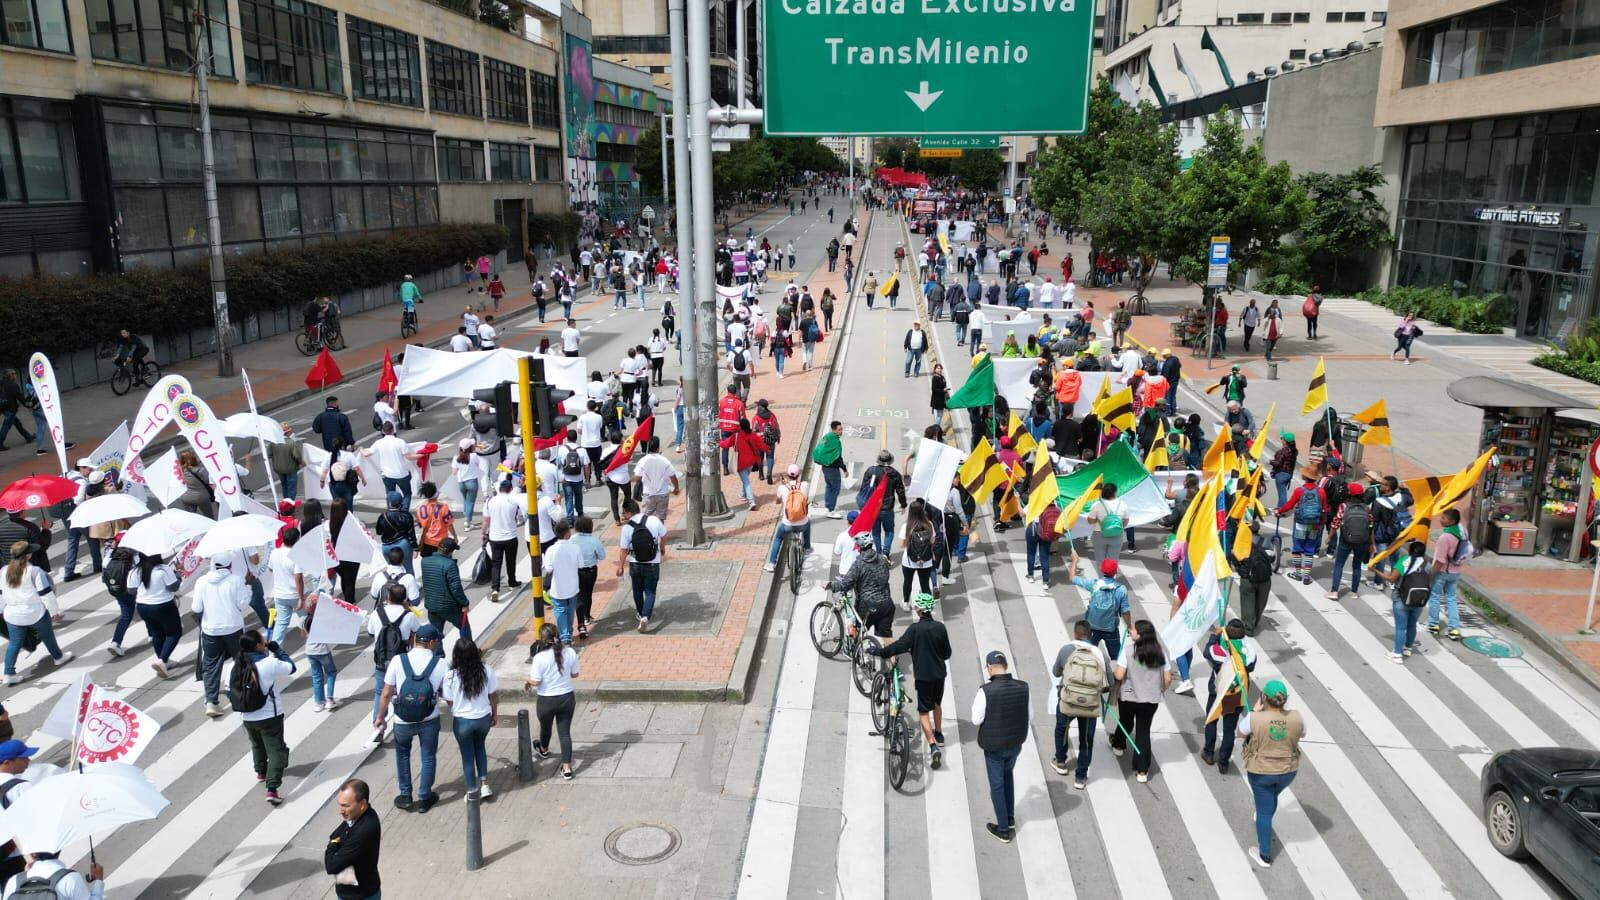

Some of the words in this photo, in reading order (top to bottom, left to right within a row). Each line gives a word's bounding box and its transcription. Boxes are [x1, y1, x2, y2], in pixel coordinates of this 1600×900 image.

[782, 0, 905, 15] Calzada
[921, 0, 1077, 14] Exclusiva
[825, 37, 1029, 65] TransMilenio
[1480, 208, 1518, 223] ANYTIME
[1518, 210, 1561, 225] FITNESS
[129, 402, 170, 454] CTC
[194, 429, 237, 496] CTC
[87, 717, 123, 744] CTC
